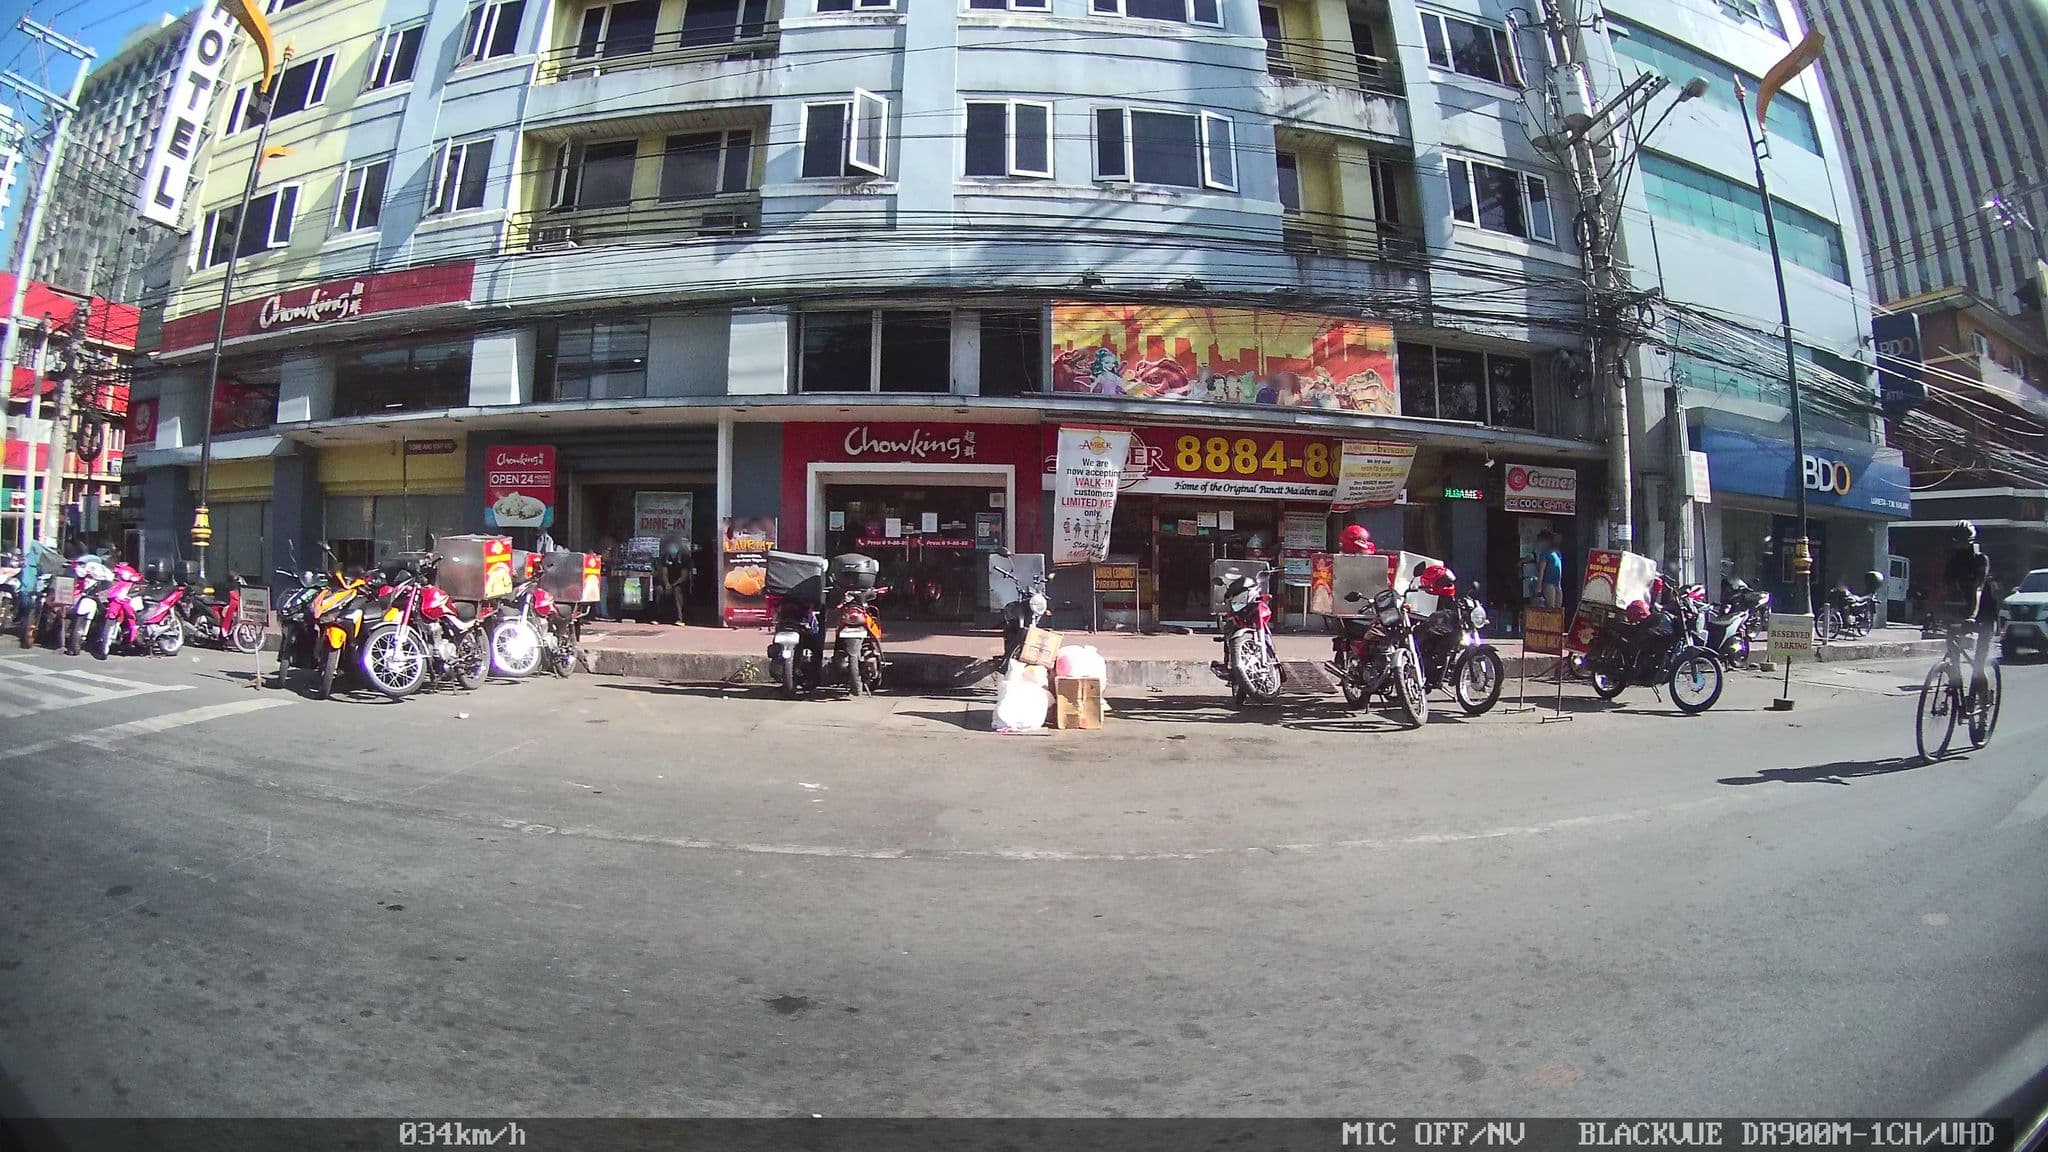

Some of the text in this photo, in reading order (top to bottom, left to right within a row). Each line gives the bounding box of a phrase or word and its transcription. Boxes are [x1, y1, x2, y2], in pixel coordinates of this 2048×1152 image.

[260, 287, 350, 328] Chowking
[1880, 337, 1914, 356] BDO
[844, 426, 961, 459] Chowking
[496, 453, 538, 466] Chowking
[1082, 458, 1109, 468] We are
[1066, 468, 1084, 476] now
[1804, 454, 1852, 496] BDO
[491, 474, 519, 484] OPEN
[520, 474, 534, 484] 24
[1075, 478, 1114, 488] WALK-IN
[1074, 489, 1114, 498] customers
[1174, 481, 1199, 490] Home
[1200, 481, 1211, 493] of
[1210, 482, 1223, 491] the
[1223, 483, 1257, 496] Original
[1259, 485, 1283, 495] Pancit
[1284, 486, 1318, 497] Maabon
[1062, 497, 1097, 508] LIMITED
[1519, 499, 1541, 509] COOL
[641, 518, 686, 530] DINE-IN
[1770, 630, 1810, 639] RESERVED
[1774, 641, 1808, 650] PARKING
